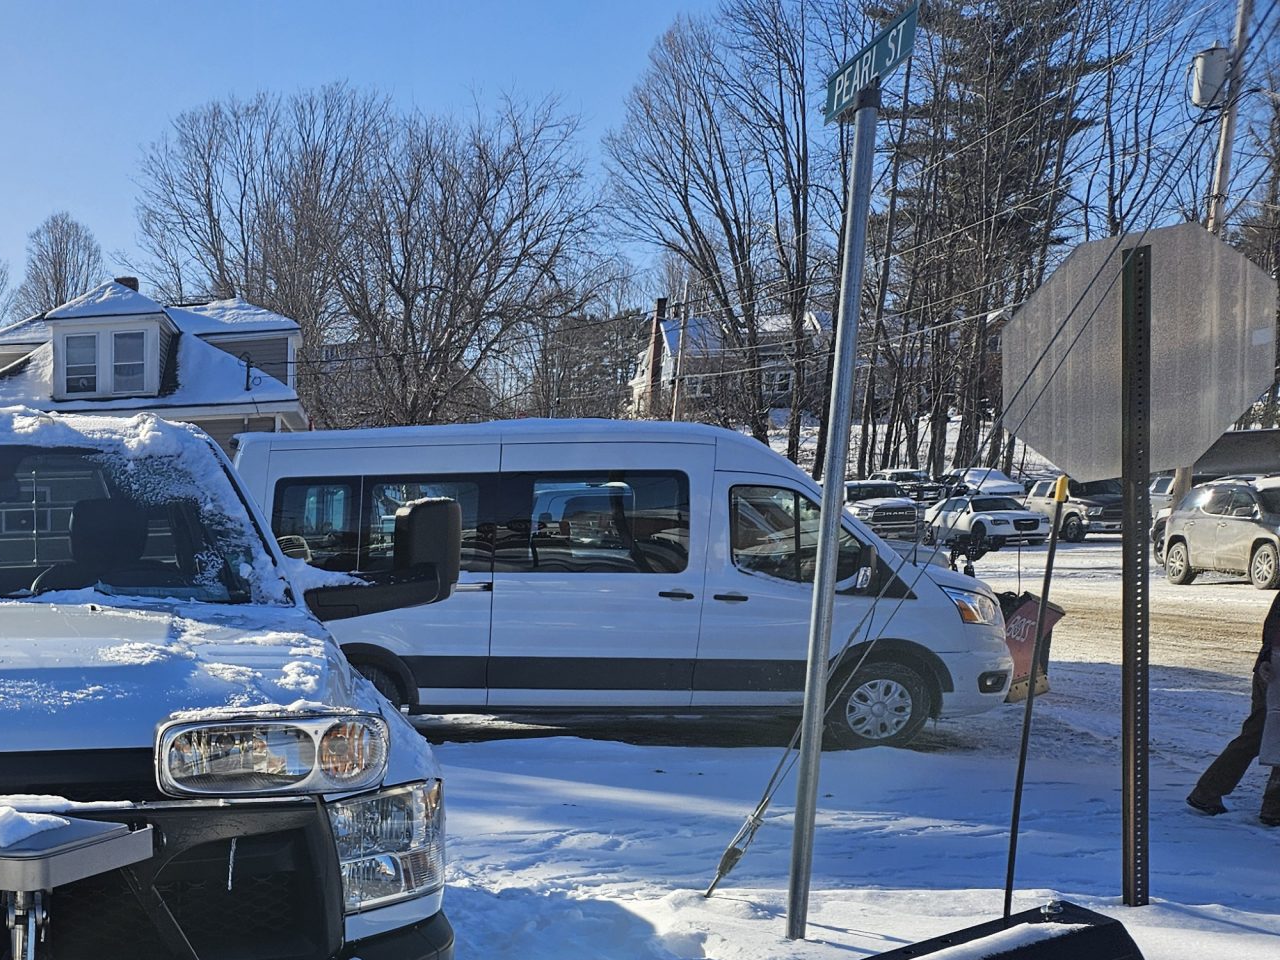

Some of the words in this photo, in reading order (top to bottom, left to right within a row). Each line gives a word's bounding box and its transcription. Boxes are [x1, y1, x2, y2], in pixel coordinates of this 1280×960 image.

[834, 45, 879, 111] PEARL
[886, 20, 907, 67] ST
[1006, 615, 1037, 643] BOSS
